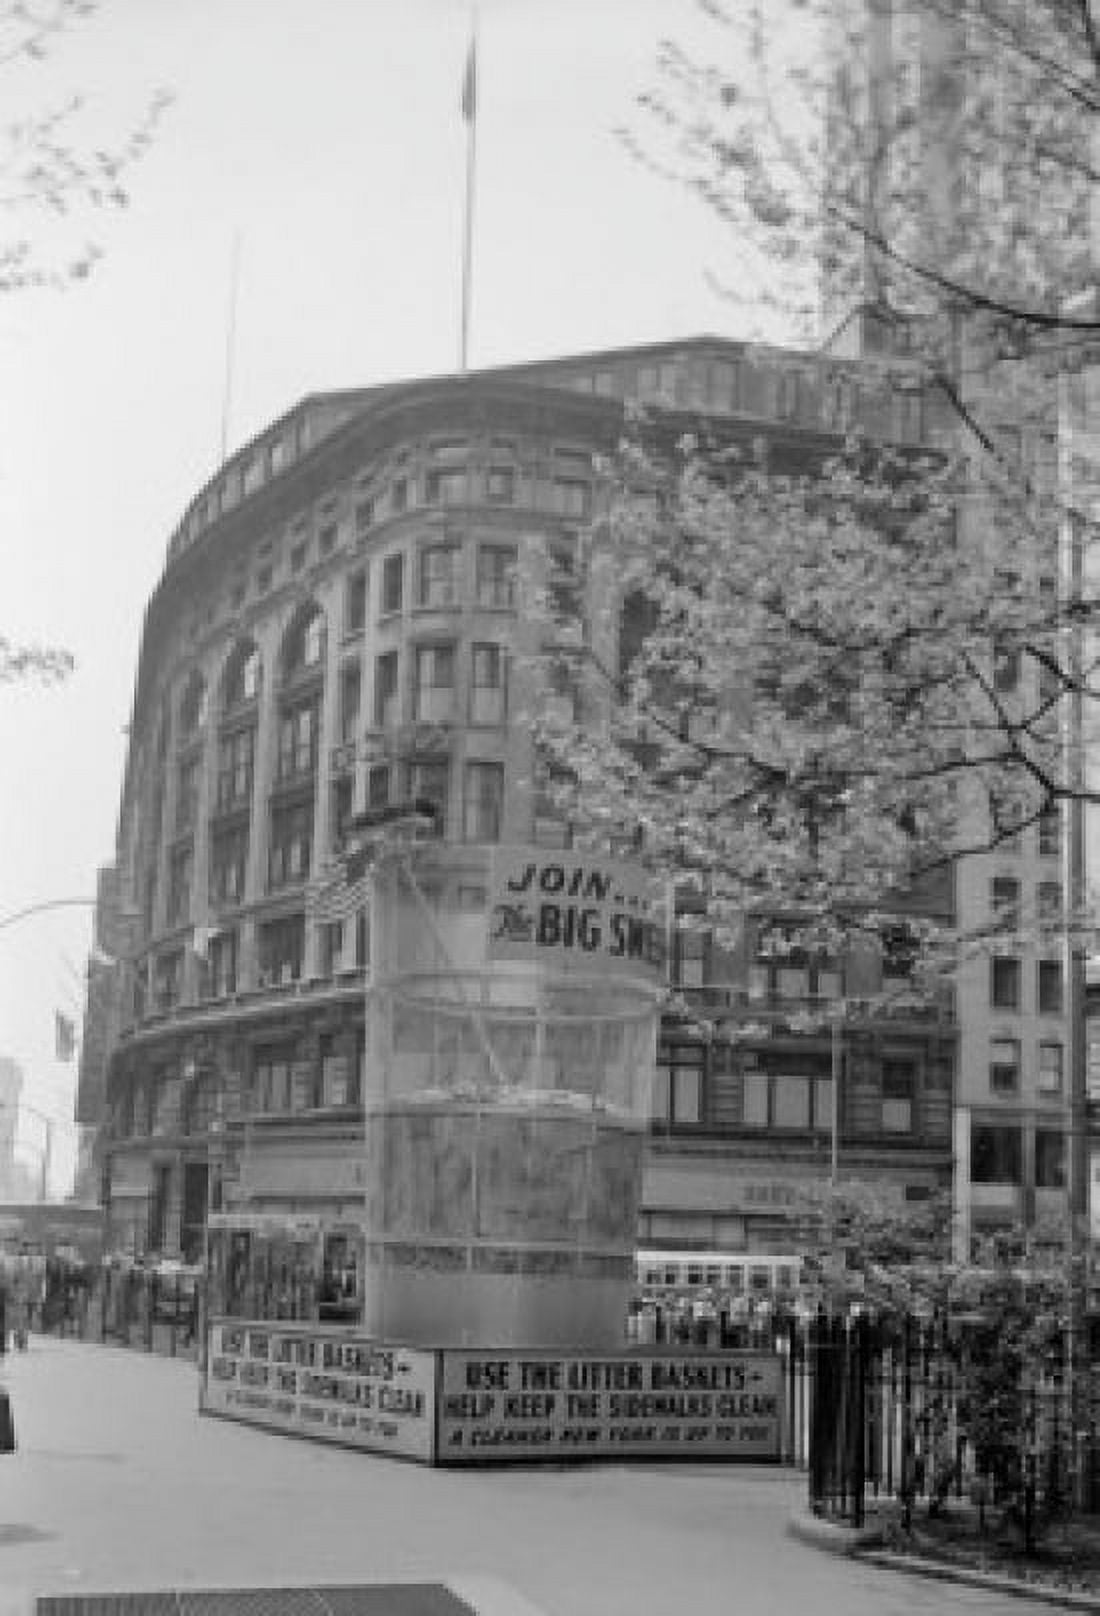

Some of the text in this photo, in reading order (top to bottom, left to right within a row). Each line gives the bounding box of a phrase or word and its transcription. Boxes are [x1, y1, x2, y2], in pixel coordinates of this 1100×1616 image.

[536, 903, 602, 951] BIG
[466, 1361, 509, 1390] USE
[517, 1361, 561, 1390] THE
[567, 1394, 600, 1418] THE
